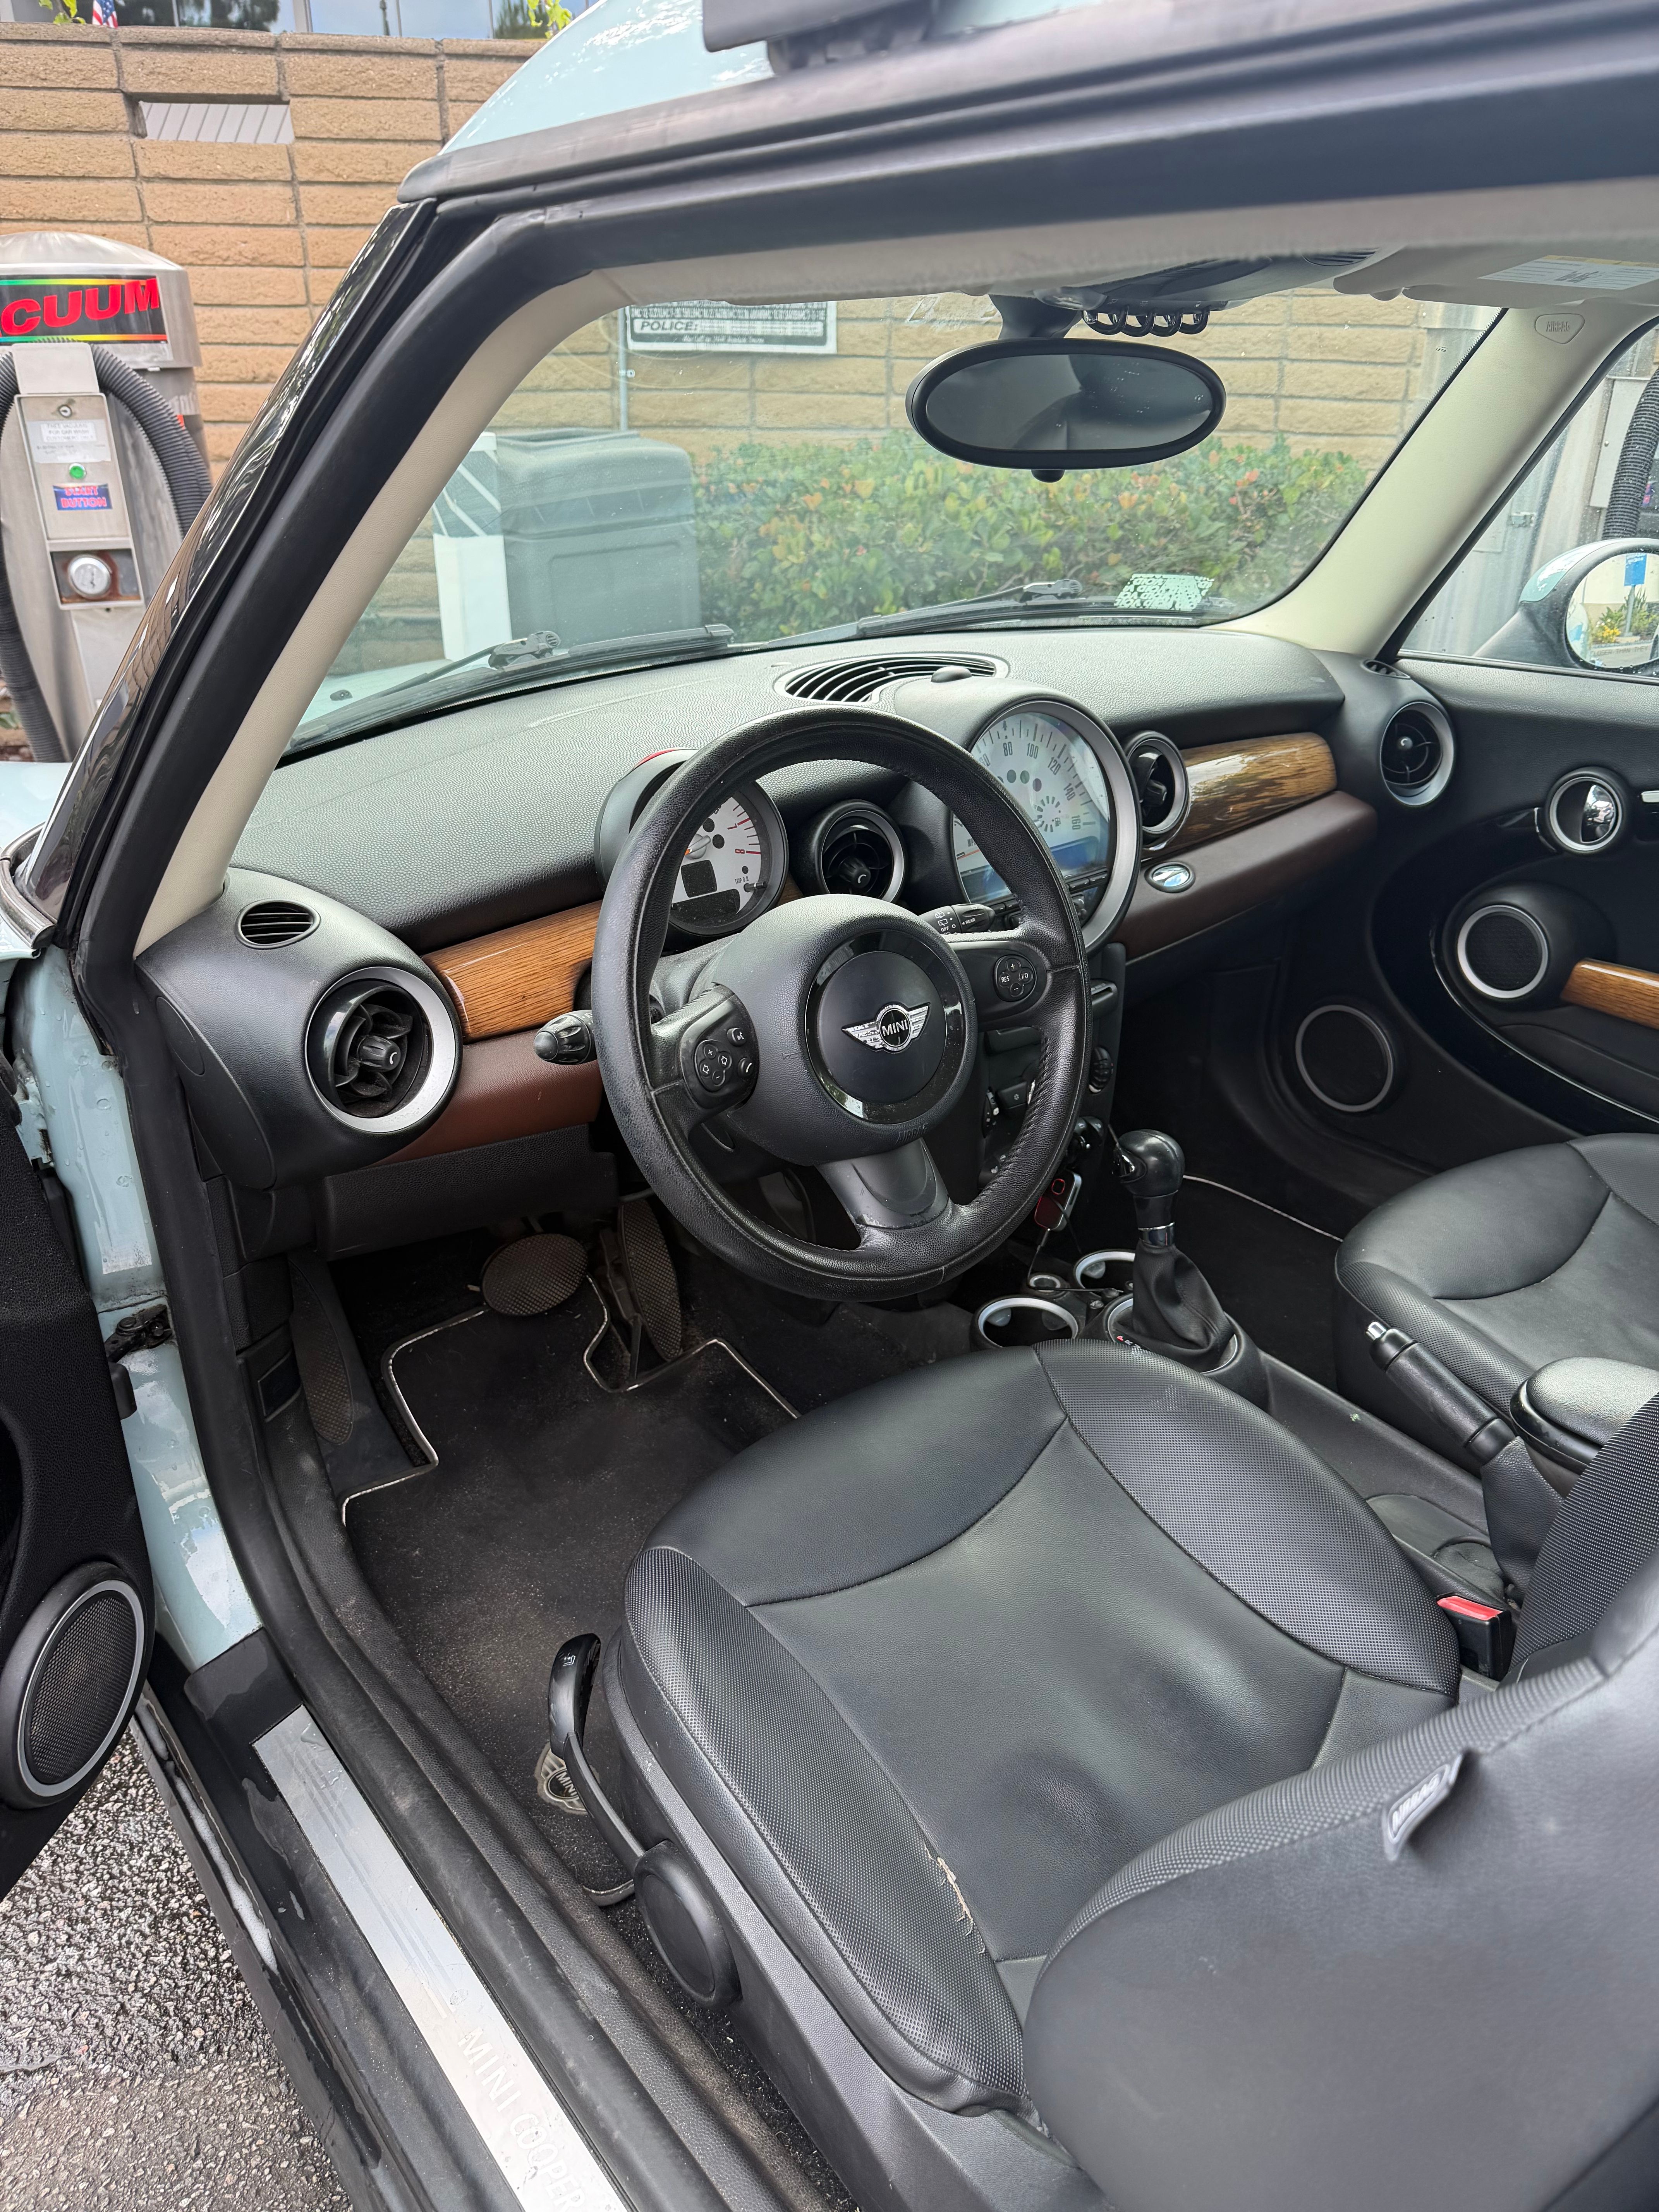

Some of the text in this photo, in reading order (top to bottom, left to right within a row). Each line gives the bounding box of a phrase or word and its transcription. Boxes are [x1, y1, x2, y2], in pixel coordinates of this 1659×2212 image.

[0, 278, 159, 337] CUUM
[640, 321, 698, 331] POLICE:
[1546, 321, 1570, 332] AIRBAG
[60, 496, 107, 508] BUTTON
[1003, 741, 1013, 756] 80
[1026, 743, 1039, 759] 100
[1047, 757, 1061, 775] 120
[1063, 783, 1076, 801] 140
[1071, 814, 1081, 830] 160
[882, 1019, 908, 1036] MINI
[556, 1771, 577, 1796] MINI
[457, 2027, 585, 2209] MINI COOPER
